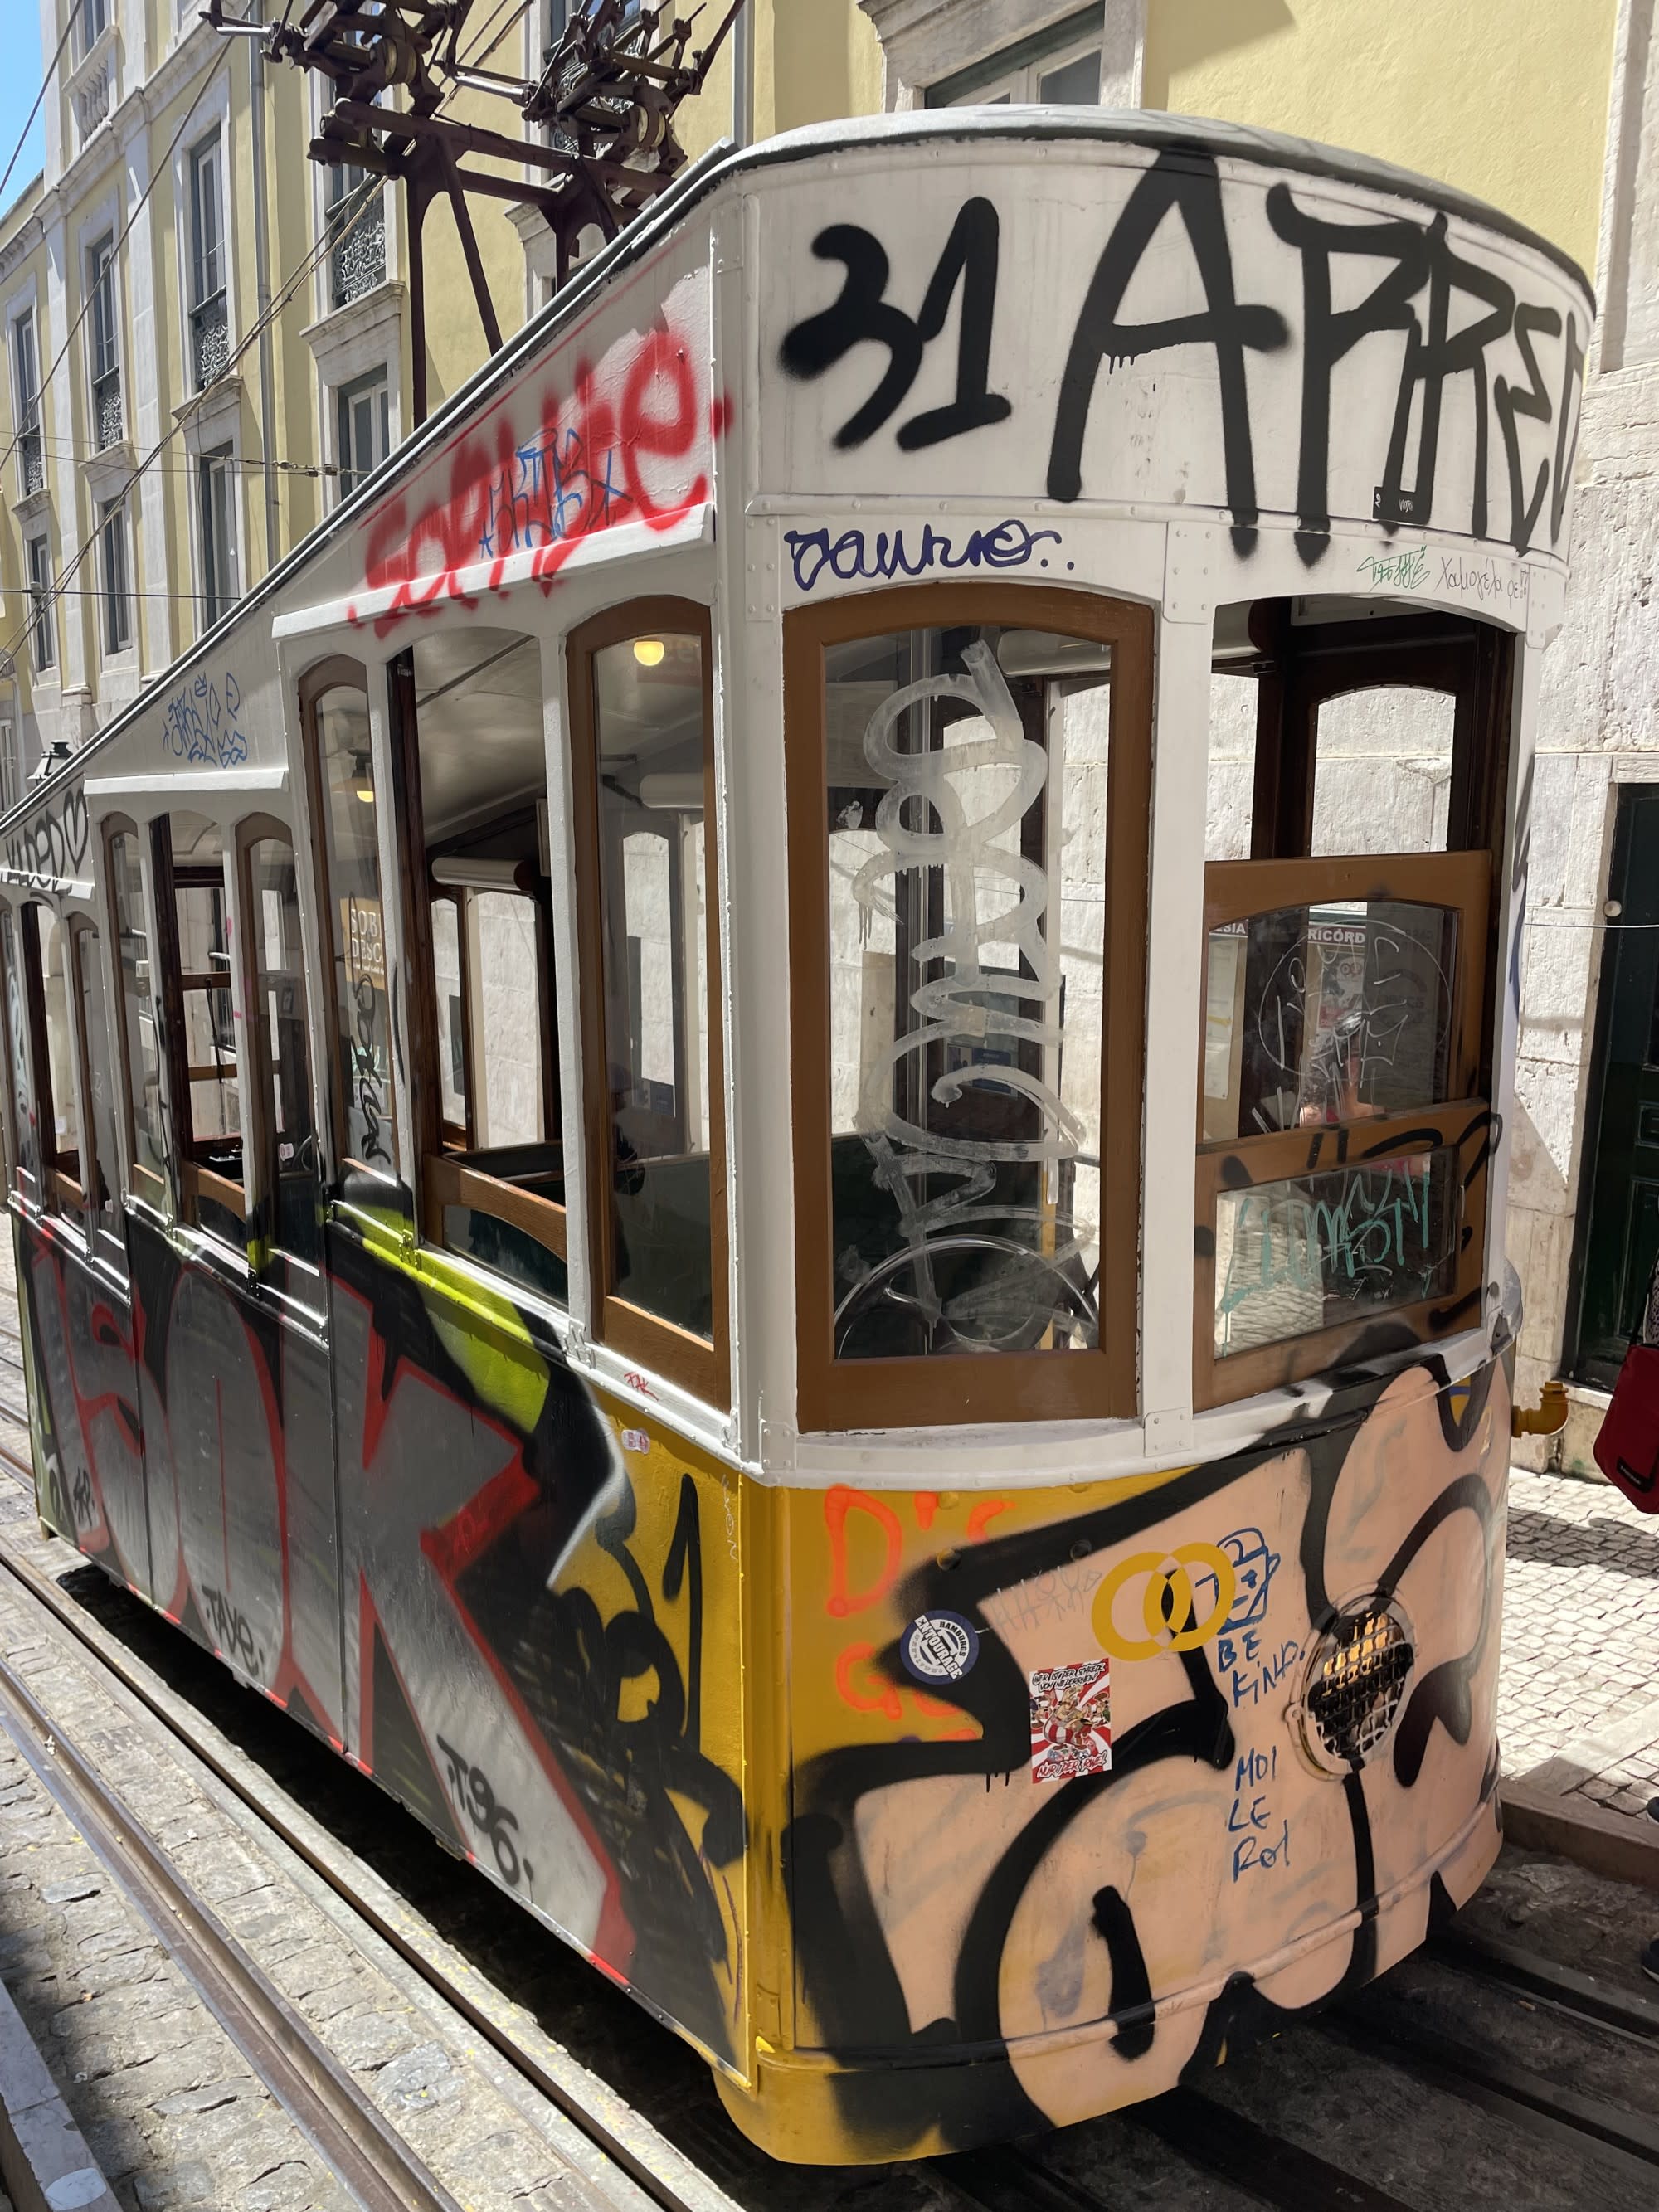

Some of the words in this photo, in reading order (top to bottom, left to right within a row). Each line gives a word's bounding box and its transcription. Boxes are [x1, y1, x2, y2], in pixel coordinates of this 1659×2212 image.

[914, 1615, 963, 1680] ENTOURAGE
[939, 1621, 967, 1657] HAMBURGS
[1218, 1629, 1262, 1673] BE
[1228, 1795, 1272, 1832] LE
